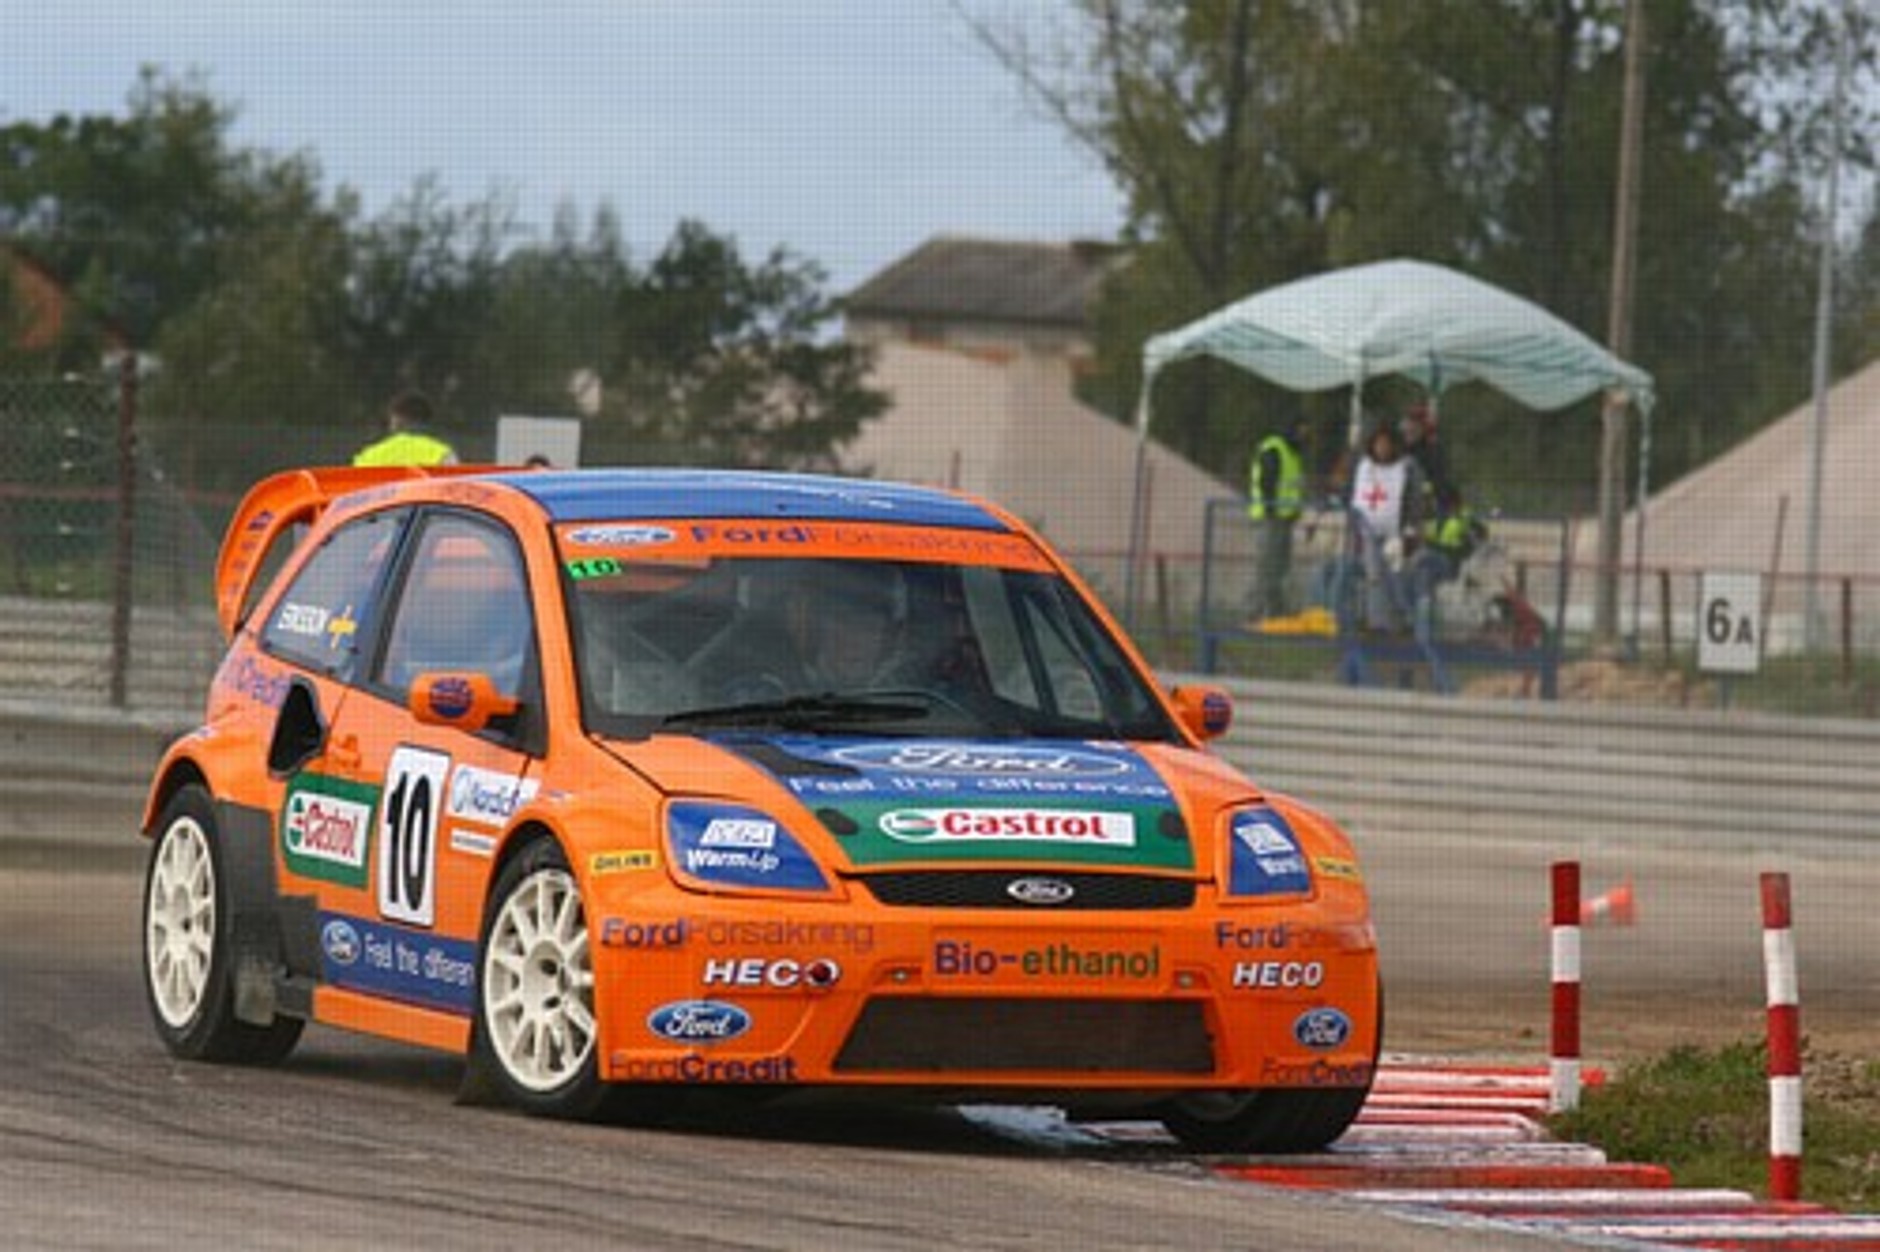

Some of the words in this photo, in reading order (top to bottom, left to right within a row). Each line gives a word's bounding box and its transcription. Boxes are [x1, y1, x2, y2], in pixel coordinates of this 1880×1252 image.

[571, 559, 615, 577] 10
[891, 742, 1077, 772] Ford
[789, 777, 875, 793] Feel
[891, 776, 957, 791] the
[977, 777, 1170, 797] difference
[942, 811, 1109, 839] Castrol
[387, 770, 432, 912] 10
[934, 938, 1160, 978] Bio-ethanol
[703, 958, 842, 987] HECO
[1233, 961, 1324, 987] HECO
[664, 1006, 732, 1037] Ford
[608, 1053, 797, 1081] FordCredit
